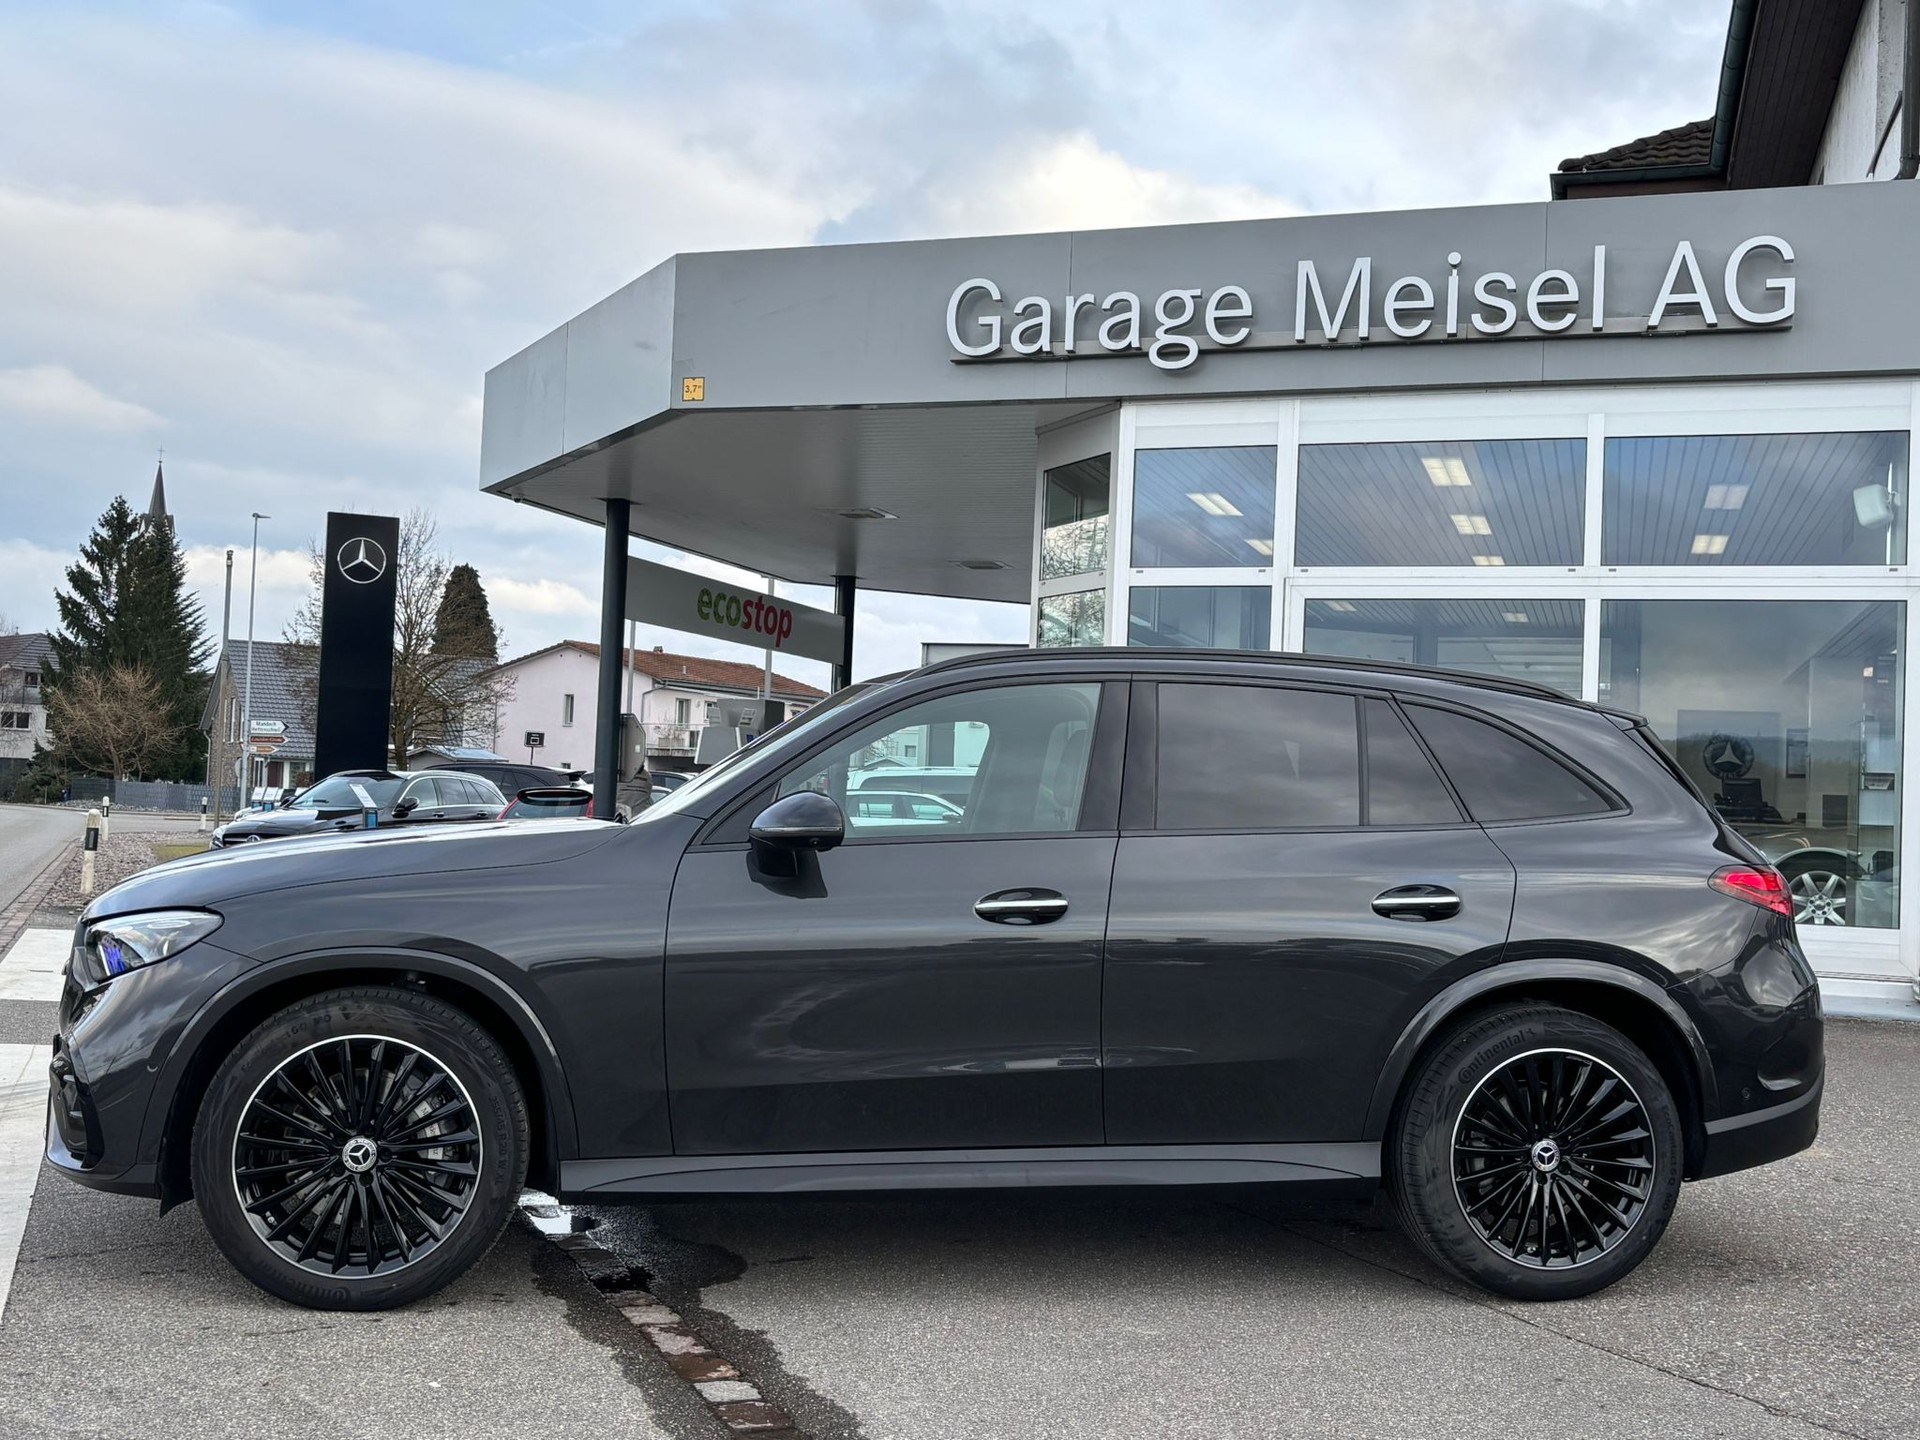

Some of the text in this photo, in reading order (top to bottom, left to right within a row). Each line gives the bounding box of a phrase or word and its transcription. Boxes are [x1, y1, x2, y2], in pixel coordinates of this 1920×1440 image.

[946, 234, 1797, 371] Garage Meisel AG
[697, 588, 792, 648] ecostop
[1458, 1030, 1526, 1085] Continental
